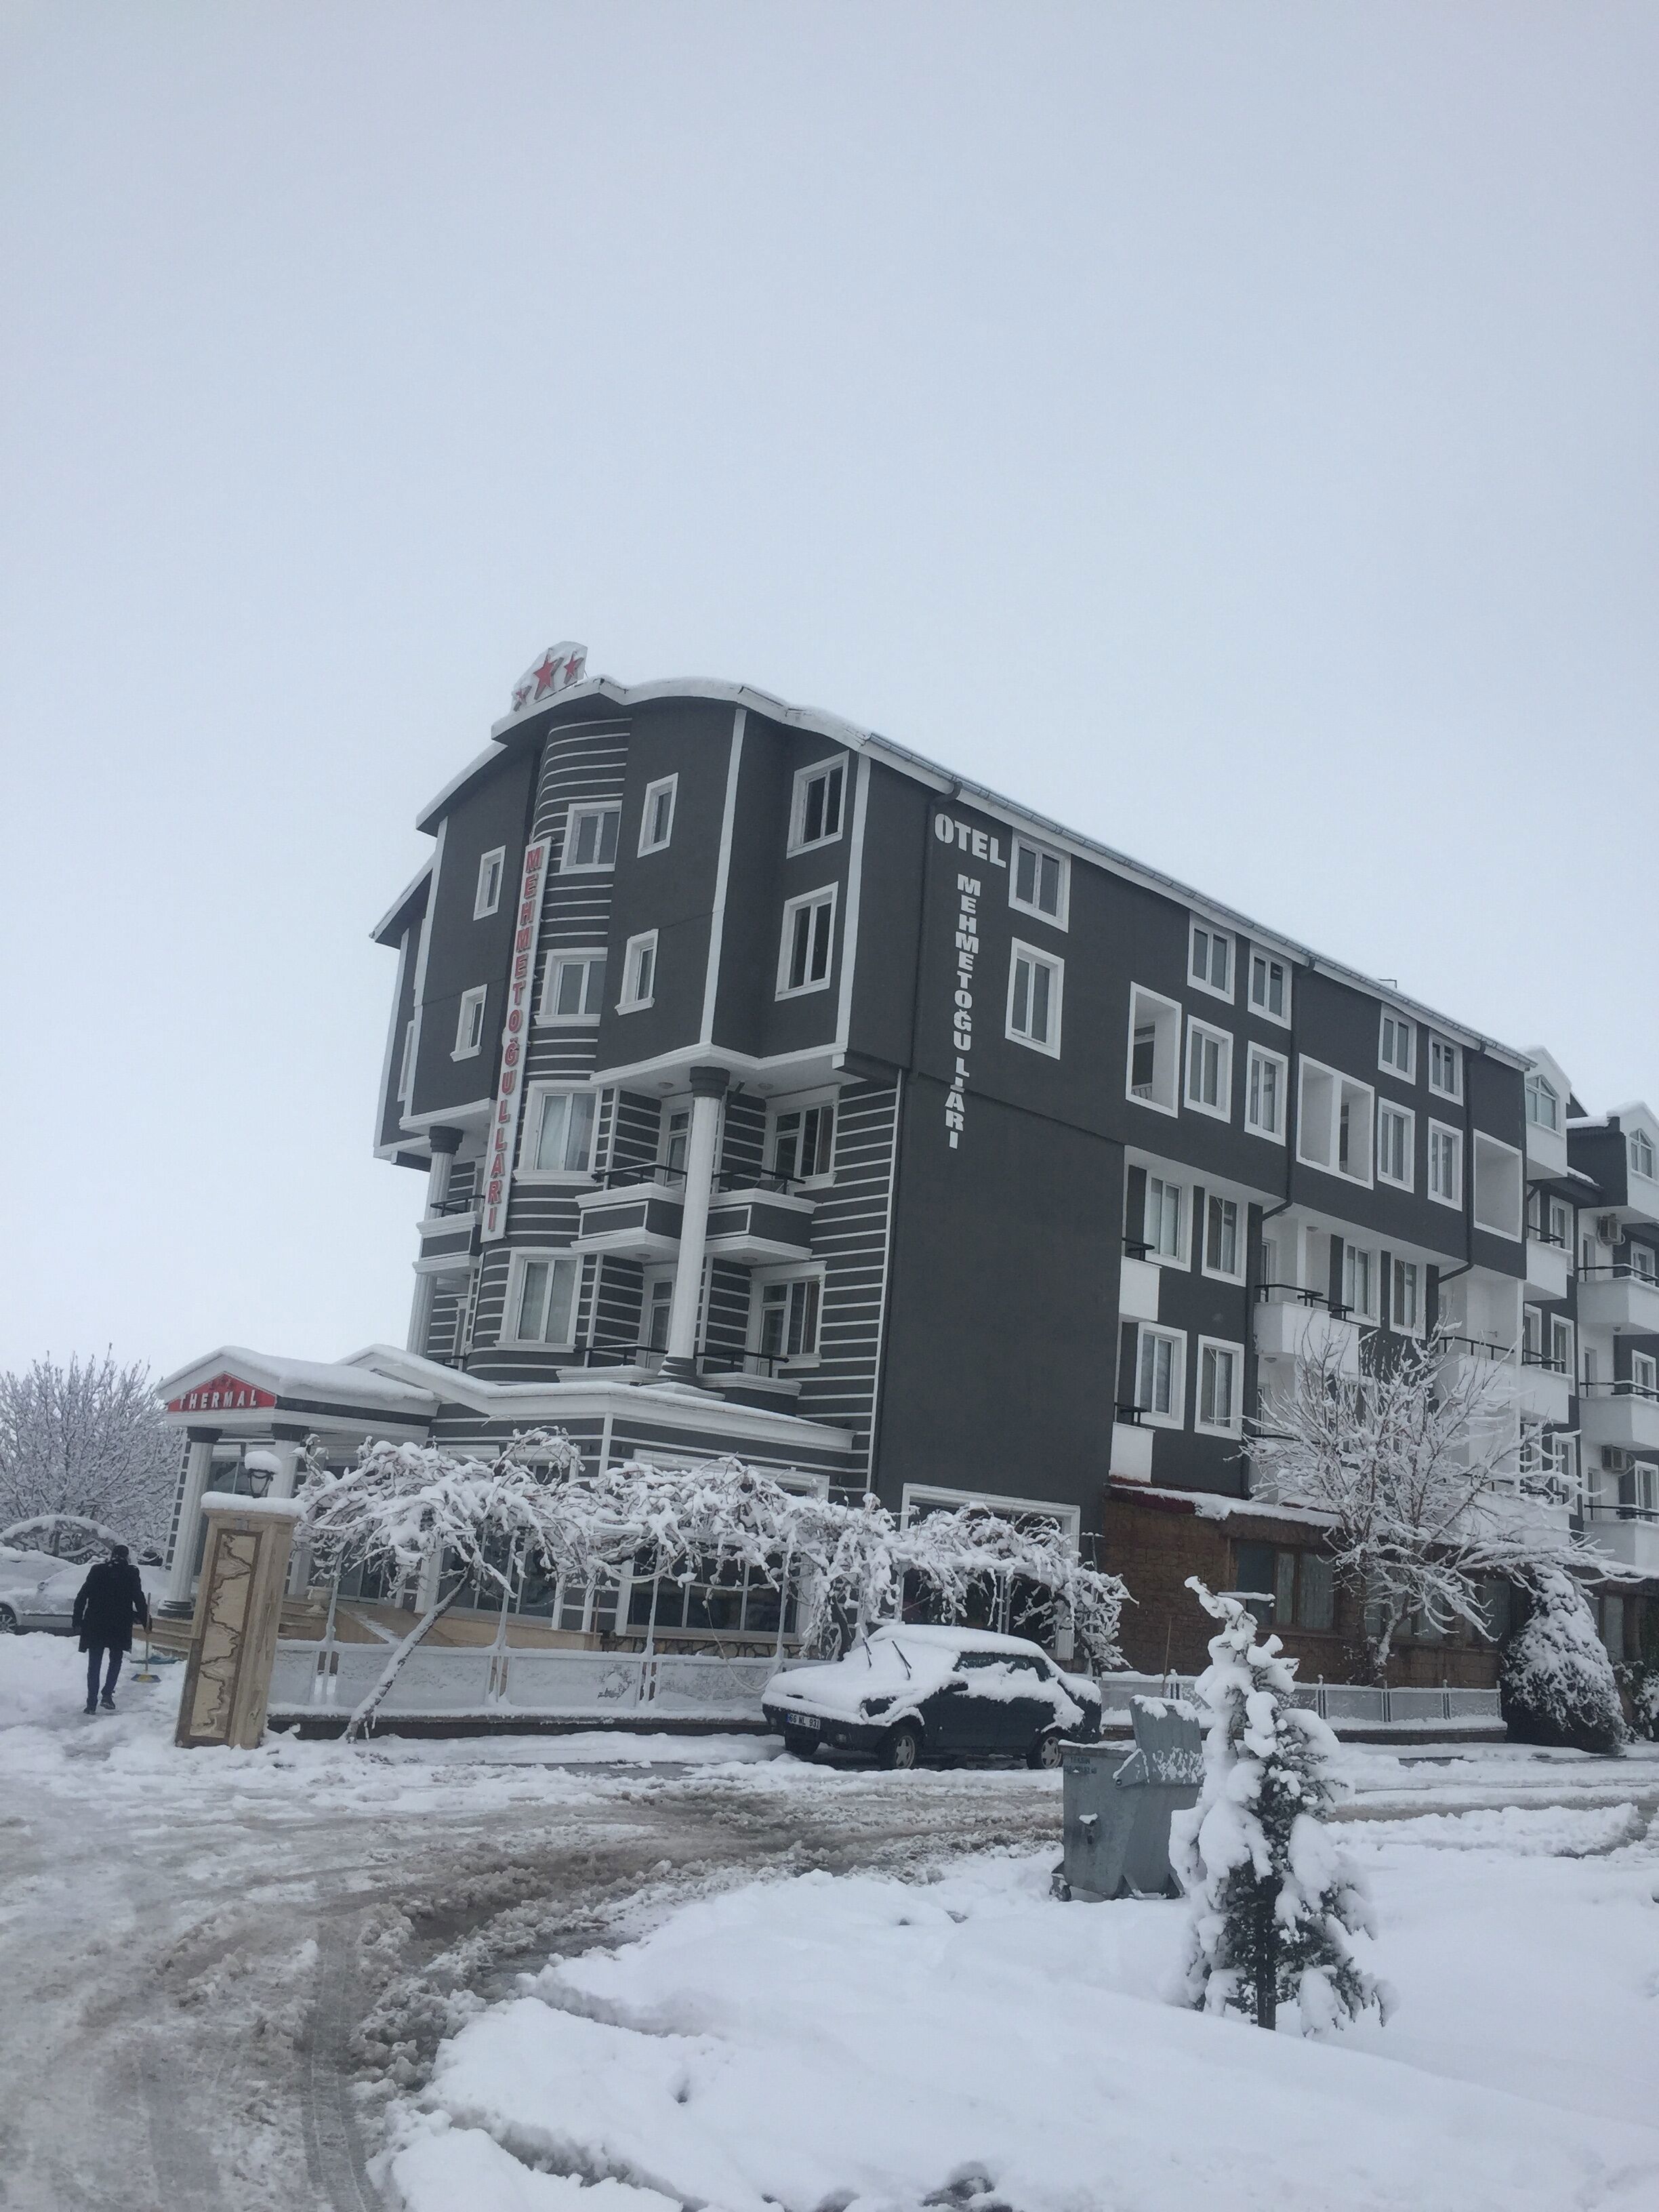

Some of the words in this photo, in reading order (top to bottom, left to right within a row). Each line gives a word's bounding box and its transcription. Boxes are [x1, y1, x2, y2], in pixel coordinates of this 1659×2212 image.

[935, 813, 1006, 868] OTEL
[488, 846, 544, 1231] MEHMETOĞULLARI
[179, 1389, 258, 1410] THERMAL
